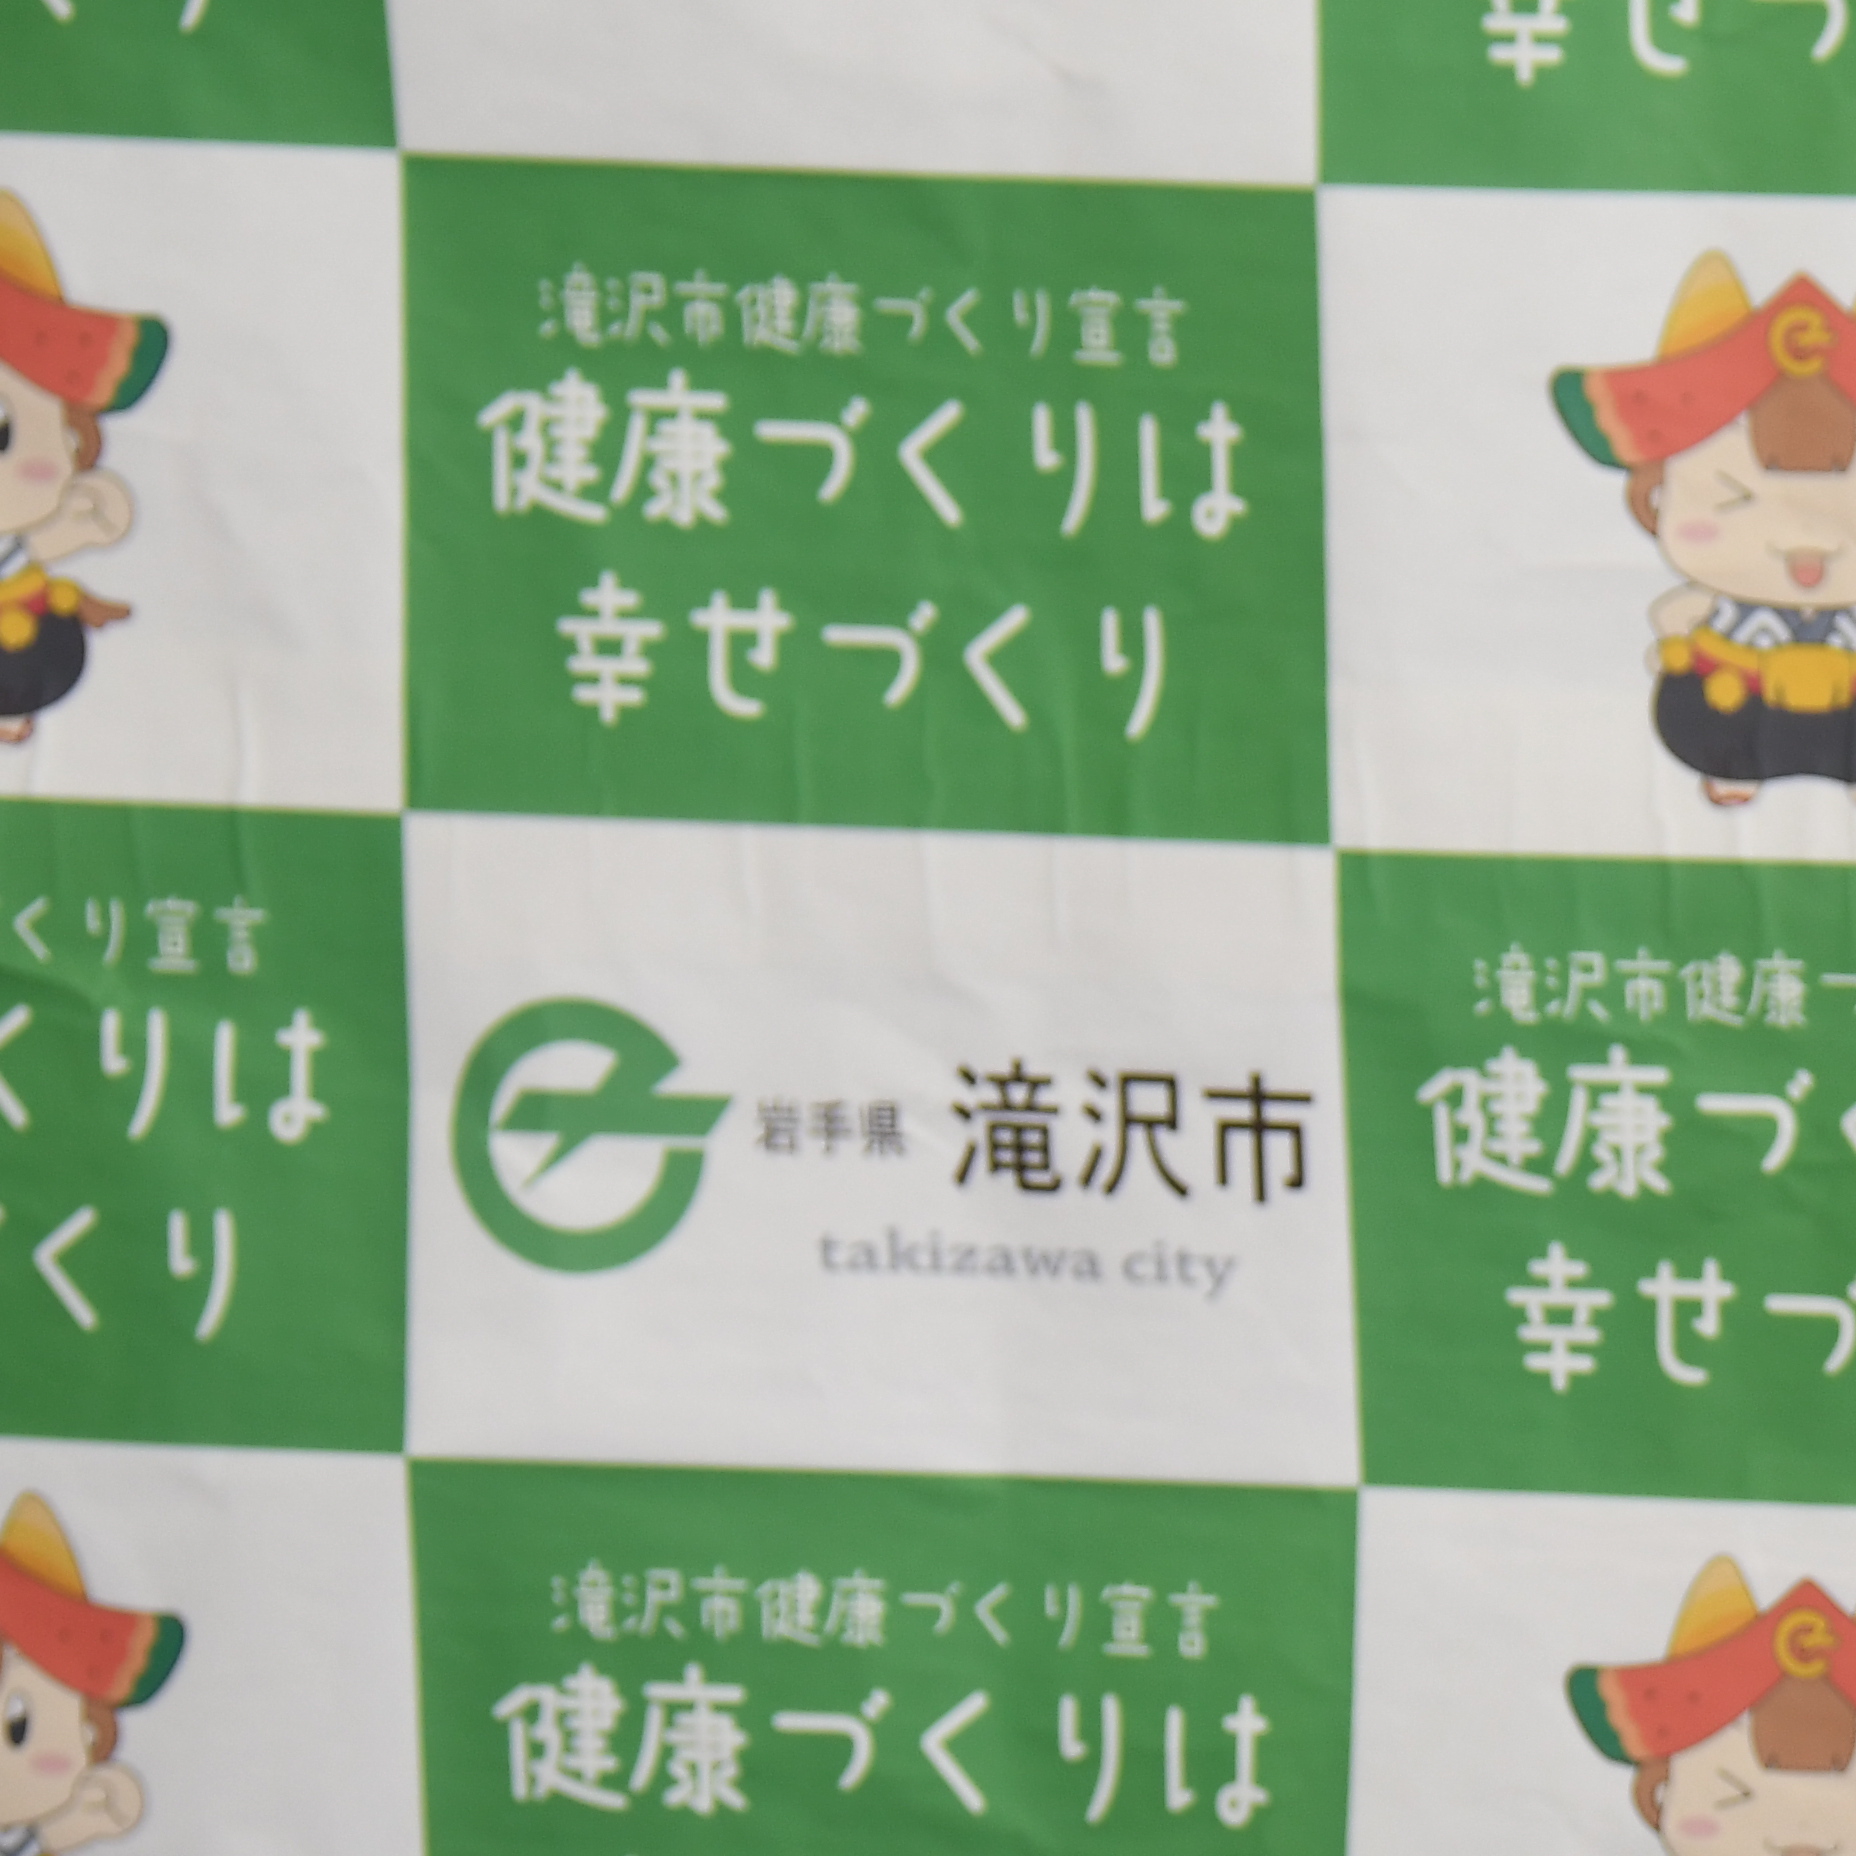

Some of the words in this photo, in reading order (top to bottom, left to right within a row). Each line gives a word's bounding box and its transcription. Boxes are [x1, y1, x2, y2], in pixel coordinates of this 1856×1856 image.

[540, 266, 1186, 367] 滝沢市健康づくり宣言
[476, 367, 1249, 542] 健康づくりは
[556, 569, 1167, 742] 幸せづくり
[756, 1098, 905, 1155] 岩手県
[949, 1056, 1315, 1206] 滝沢市
[816, 1225, 1107, 1285] takizawa
[1117, 1238, 1238, 1302] city
[553, 1562, 1220, 1658] 滝沢市健康づくり宣言
[492, 1662, 1271, 1828] 健康づくりは
